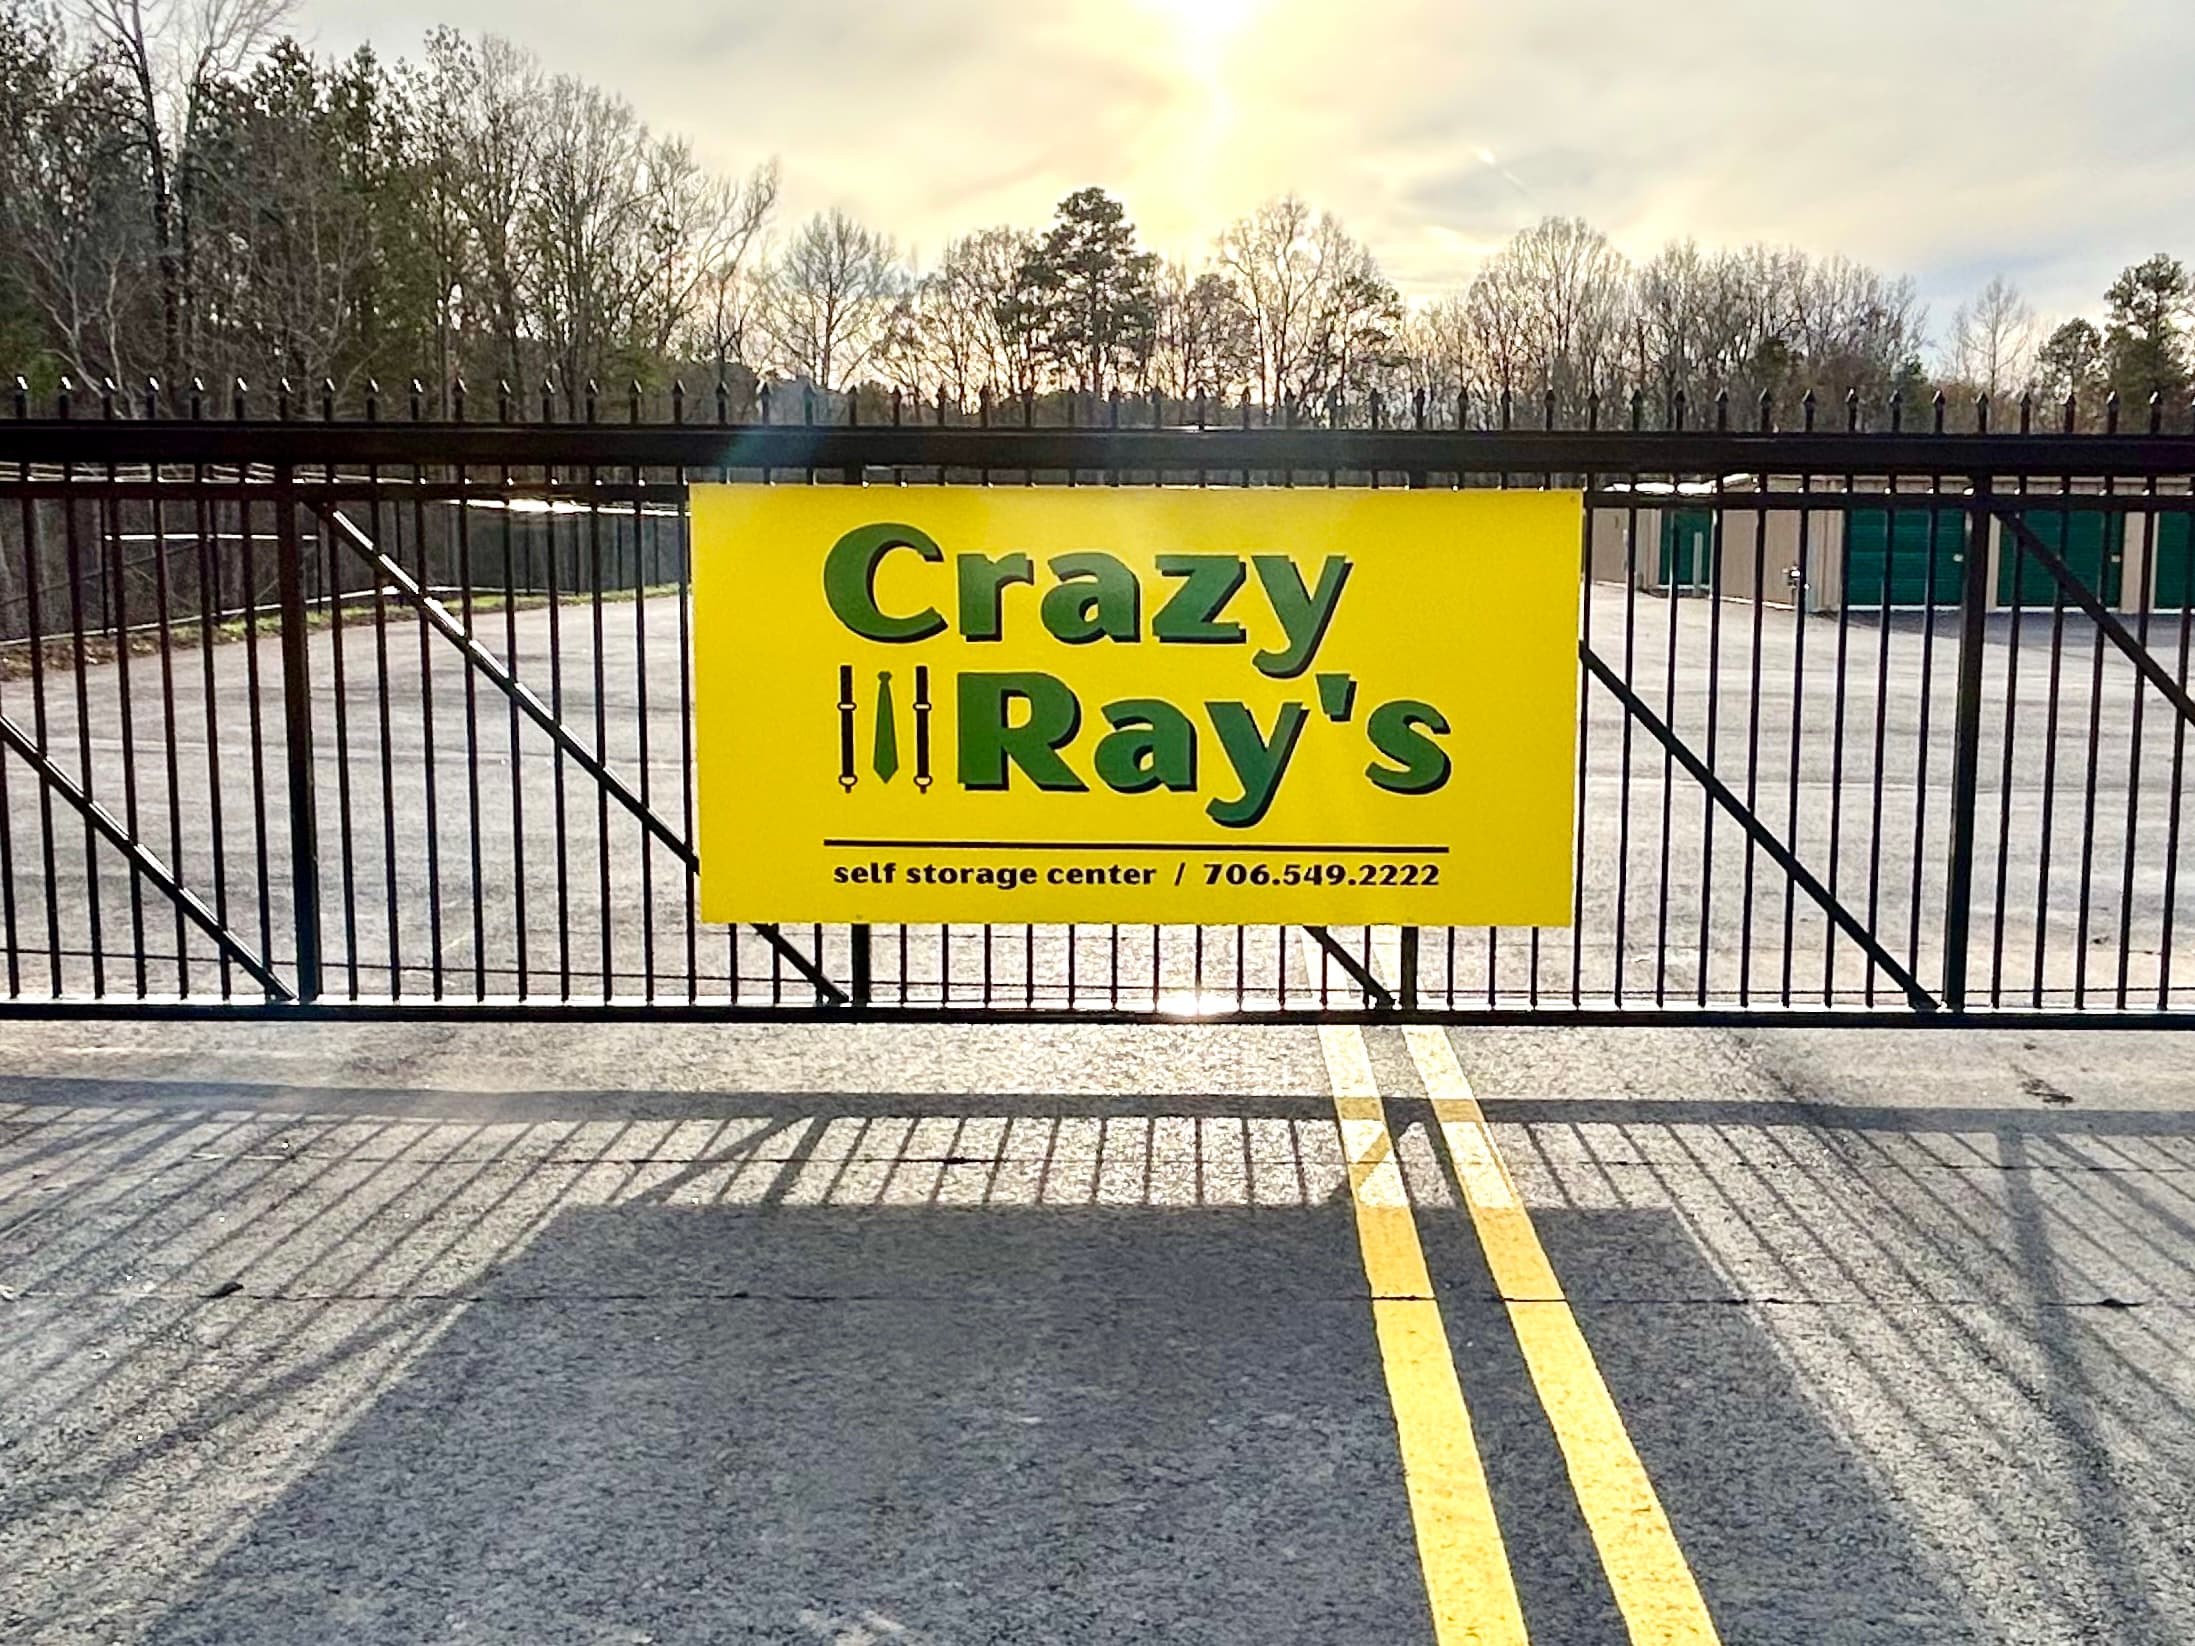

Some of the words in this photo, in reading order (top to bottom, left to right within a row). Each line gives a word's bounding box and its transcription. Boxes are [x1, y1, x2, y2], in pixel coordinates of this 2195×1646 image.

[823, 522, 1354, 680] Crazy
[956, 671, 1452, 829] Ray's
[833, 862, 897, 885] self
[906, 863, 1038, 891] storage
[1047, 864, 1157, 886] center
[1174, 862, 1186, 887] /
[1203, 863, 1439, 887] 706.549.2222
